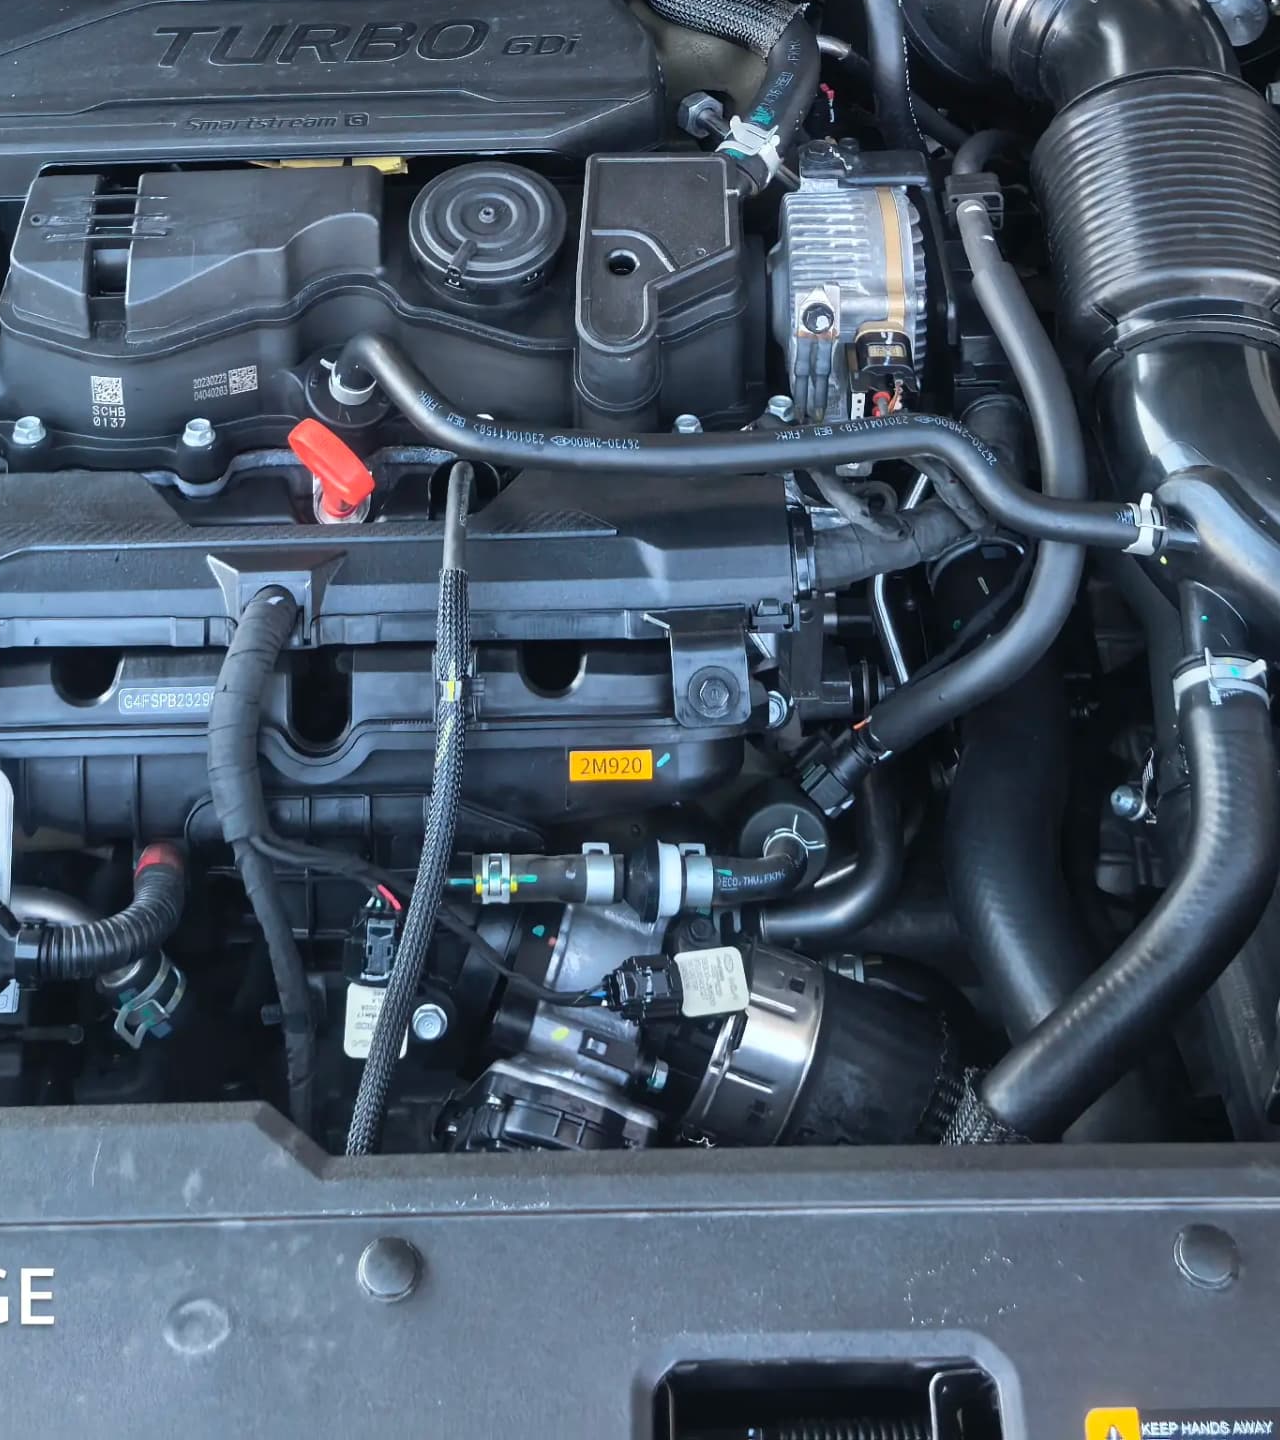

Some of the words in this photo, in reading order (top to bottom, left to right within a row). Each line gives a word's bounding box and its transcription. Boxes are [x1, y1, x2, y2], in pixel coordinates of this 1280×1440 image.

[155, 18, 490, 68] TURBO
[500, 33, 583, 57] GDi
[184, 114, 336, 132] Smartstream
[92, 405, 126, 417] SCHB
[93, 416, 127, 428] 0137
[580, 756, 643, 775] 2M920
[1140, 1421, 1177, 1436] KEEP
[1181, 1421, 1231, 1436] HANDS
[1232, 1420, 1274, 1436] AWAY
